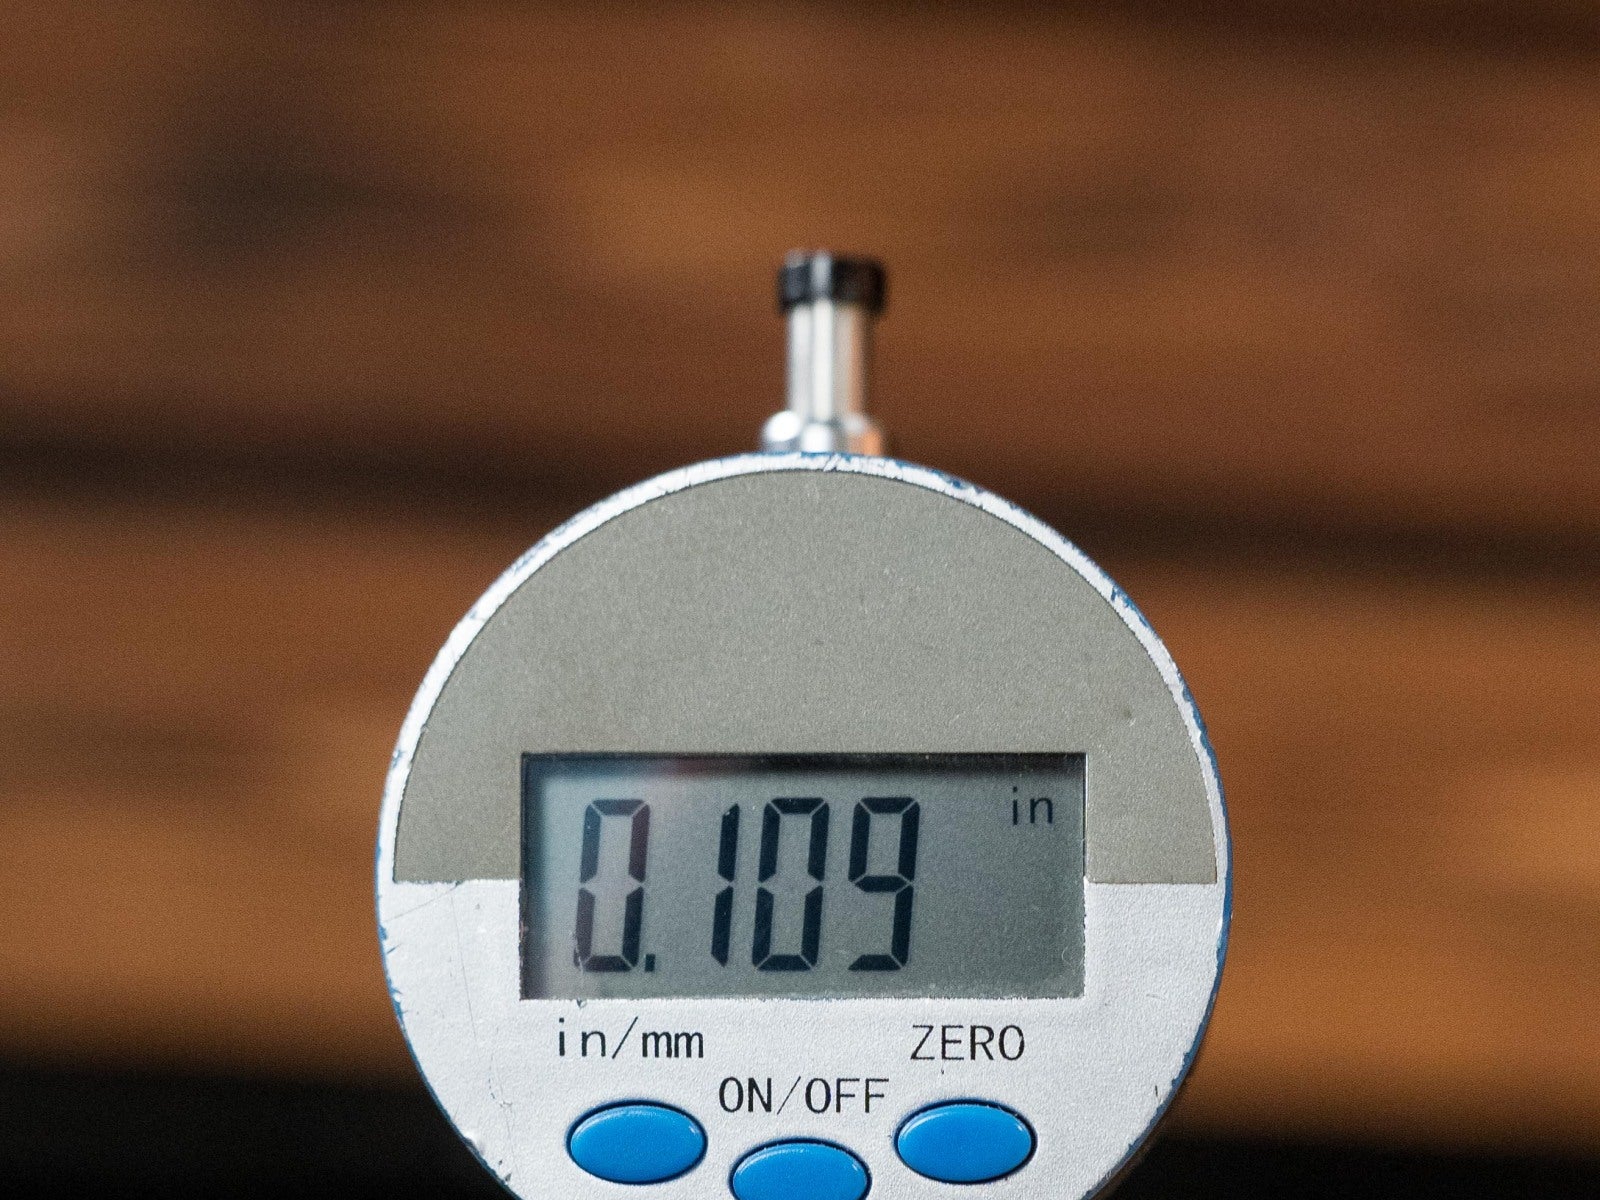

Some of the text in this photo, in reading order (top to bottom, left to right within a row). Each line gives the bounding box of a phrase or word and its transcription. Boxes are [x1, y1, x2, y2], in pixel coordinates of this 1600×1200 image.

[1012, 787, 1054, 825] in
[574, 797, 920, 972] 0.109
[557, 1016, 705, 1059] in/mm
[910, 1025, 1026, 1062] ZERO
[718, 1076, 890, 1116] ON/OFF
